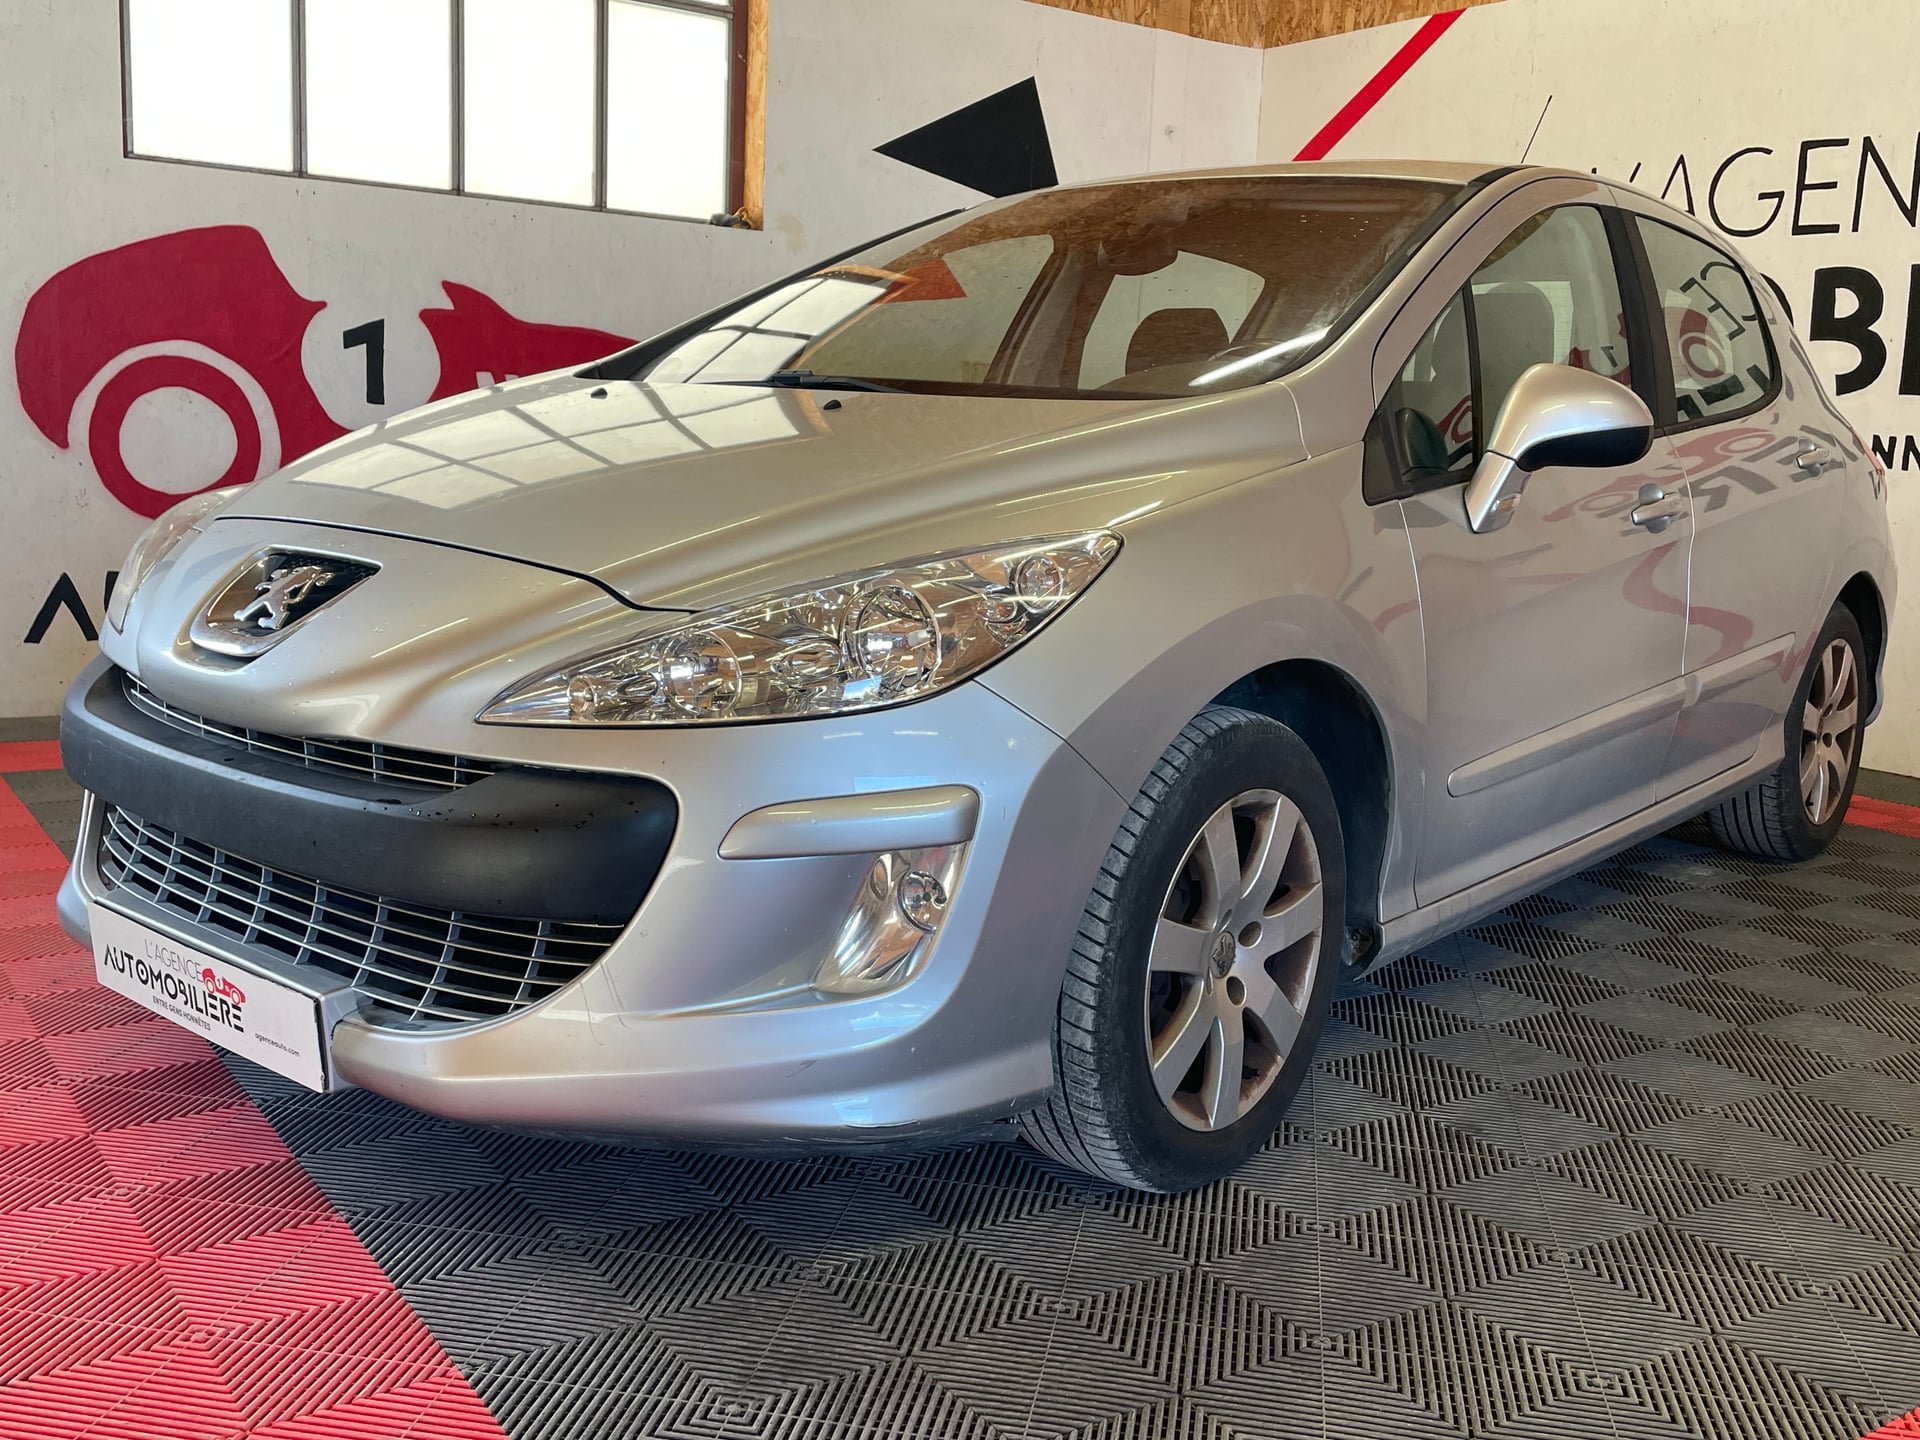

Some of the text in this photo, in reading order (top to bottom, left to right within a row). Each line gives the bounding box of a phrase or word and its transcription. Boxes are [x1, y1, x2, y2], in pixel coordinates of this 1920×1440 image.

[342, 318, 385, 405] 1
[144, 938, 204, 983] L'AGENCE
[152, 995, 169, 1010] ENTRE
[168, 1003, 183, 1018] GENS
